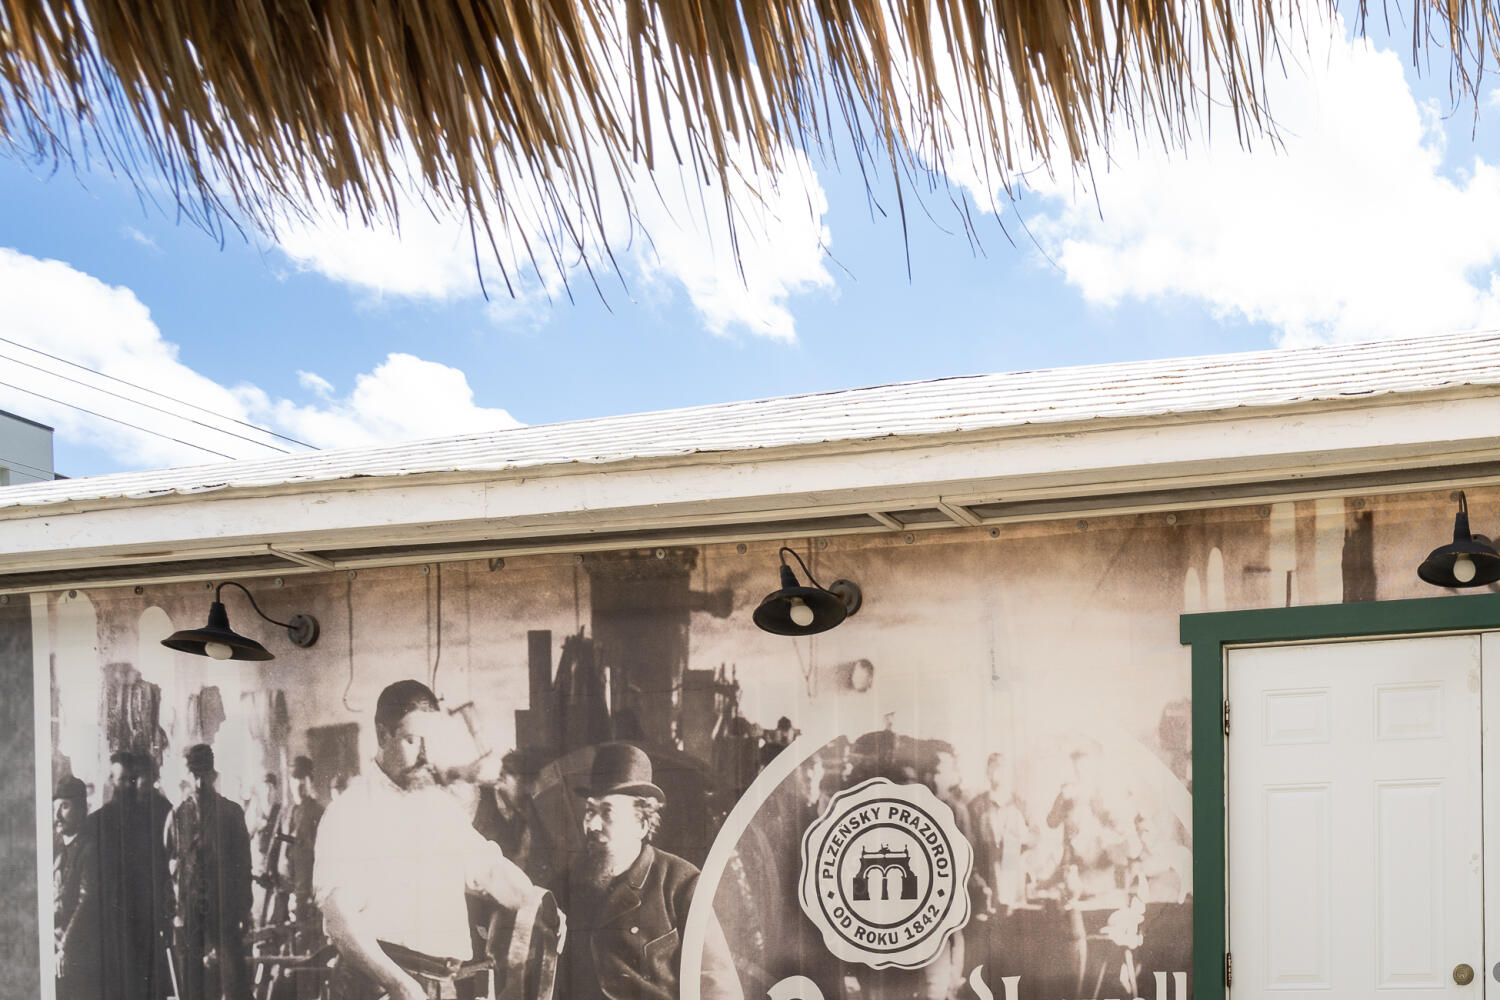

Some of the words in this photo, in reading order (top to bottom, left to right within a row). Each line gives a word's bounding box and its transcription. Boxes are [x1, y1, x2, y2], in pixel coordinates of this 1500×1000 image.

[888, 806, 949, 878] PRAZDROJ
[833, 906, 852, 929] OD
[854, 926, 899, 945] ROKU
[904, 904, 940, 940] 1842
